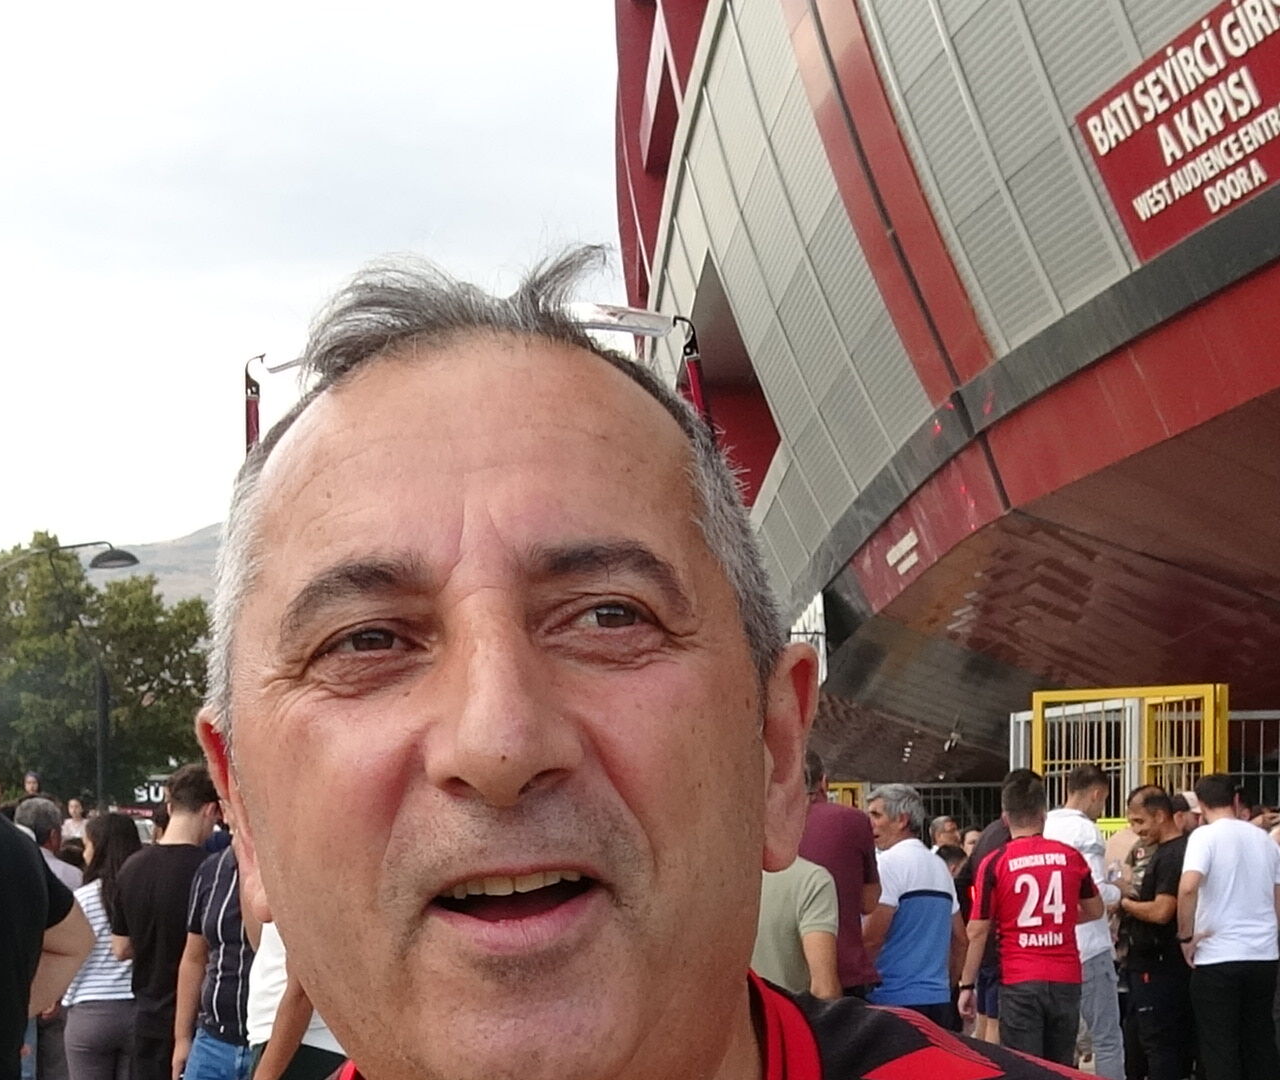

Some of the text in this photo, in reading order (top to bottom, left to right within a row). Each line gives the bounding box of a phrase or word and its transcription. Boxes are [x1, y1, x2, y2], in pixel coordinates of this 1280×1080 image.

[1086, 91, 1142, 156] BATI
[1133, 18, 1227, 124] SEYİRCİ
[1157, 65, 1262, 167] A KAPISI
[1132, 178, 1173, 222] WEST
[1169, 133, 1245, 201] AUDIENCE
[1203, 158, 1268, 214] DOOR A
[1014, 870, 1067, 928] 24
[1018, 931, 1064, 949] ŞAHİN
